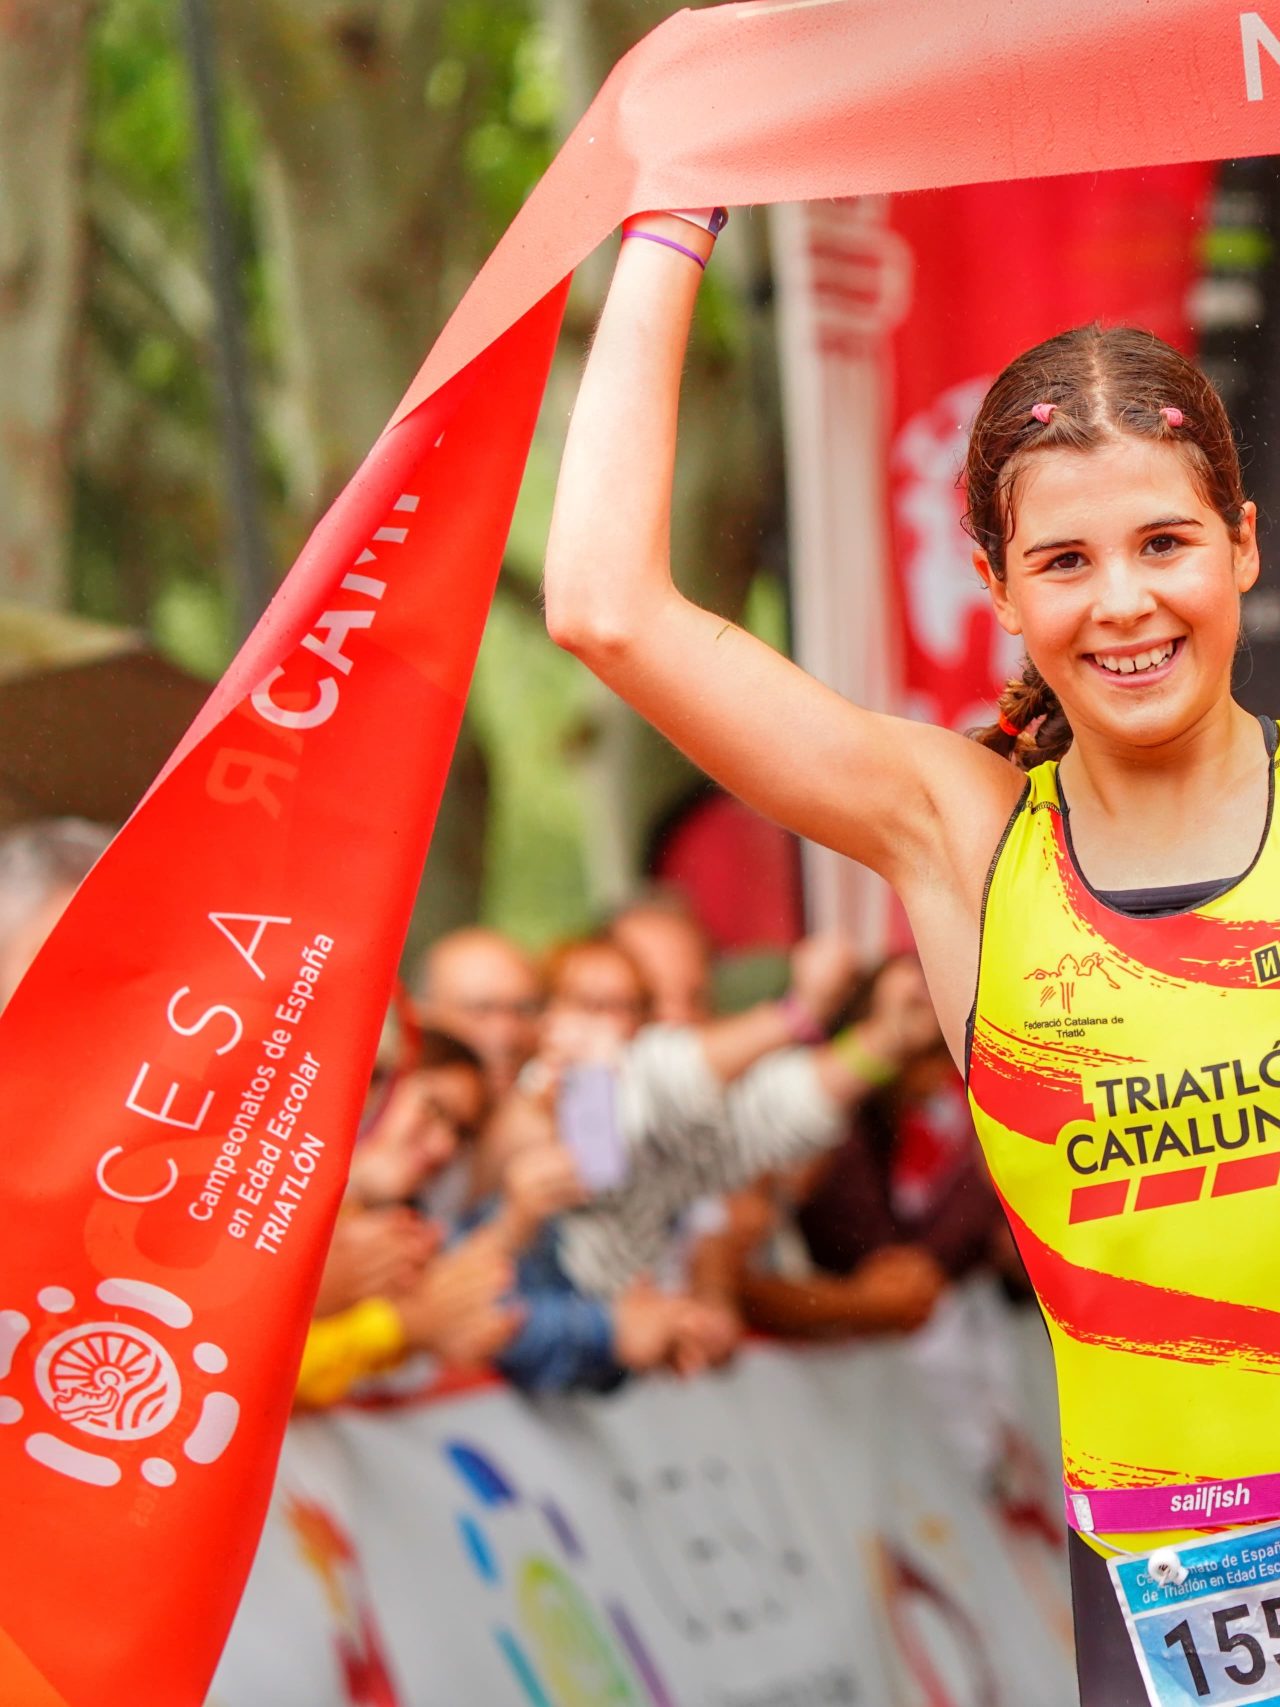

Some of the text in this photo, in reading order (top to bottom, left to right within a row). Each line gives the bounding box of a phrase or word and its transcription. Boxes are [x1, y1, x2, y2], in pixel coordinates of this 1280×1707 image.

[1024, 1015, 1124, 1030] Federació Catalana de
[1056, 1028, 1086, 1039] Triatló
[189, 932, 335, 1222] Campeonatos de España
[228, 1051, 322, 1240] en Edad Escolar
[254, 1132, 326, 1255] TRIATLÓN
[1170, 1483, 1250, 1517] sailfish
[1222, 1554, 1238, 1568] de
[1142, 1589, 1159, 1604] de
[1164, 1578, 1207, 1598] Triatlón
[1210, 1575, 1225, 1587] en
[1226, 1565, 1257, 1584] Edad
